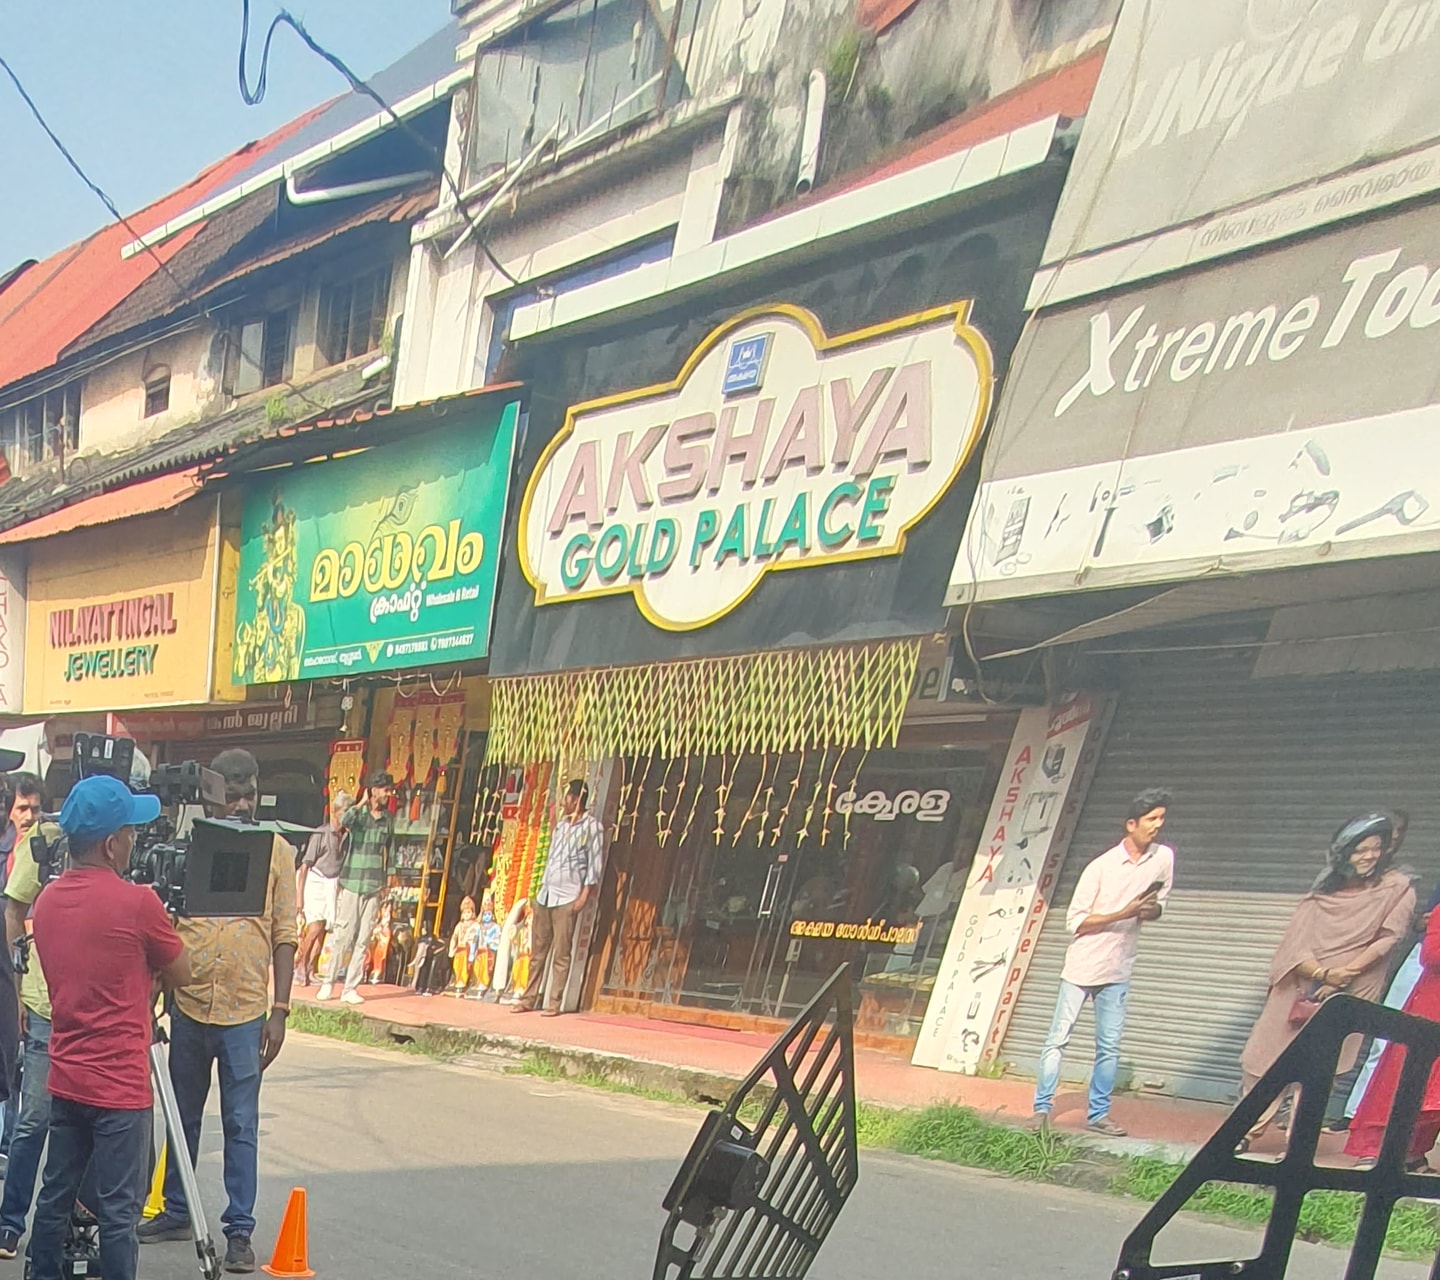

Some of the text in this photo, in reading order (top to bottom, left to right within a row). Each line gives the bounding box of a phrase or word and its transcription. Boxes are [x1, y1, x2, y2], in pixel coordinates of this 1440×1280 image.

[1055, 295, 1320, 417] Xtreme
[548, 361, 931, 535] AKSHAYA
[309, 519, 484, 603] മാധവം
[560, 475, 899, 589] GOLD PALACE
[64, 644, 159, 682] JEWELLERY
[978, 745, 1031, 883] AKSHAYA
[932, 969, 959, 1038] PALACE
